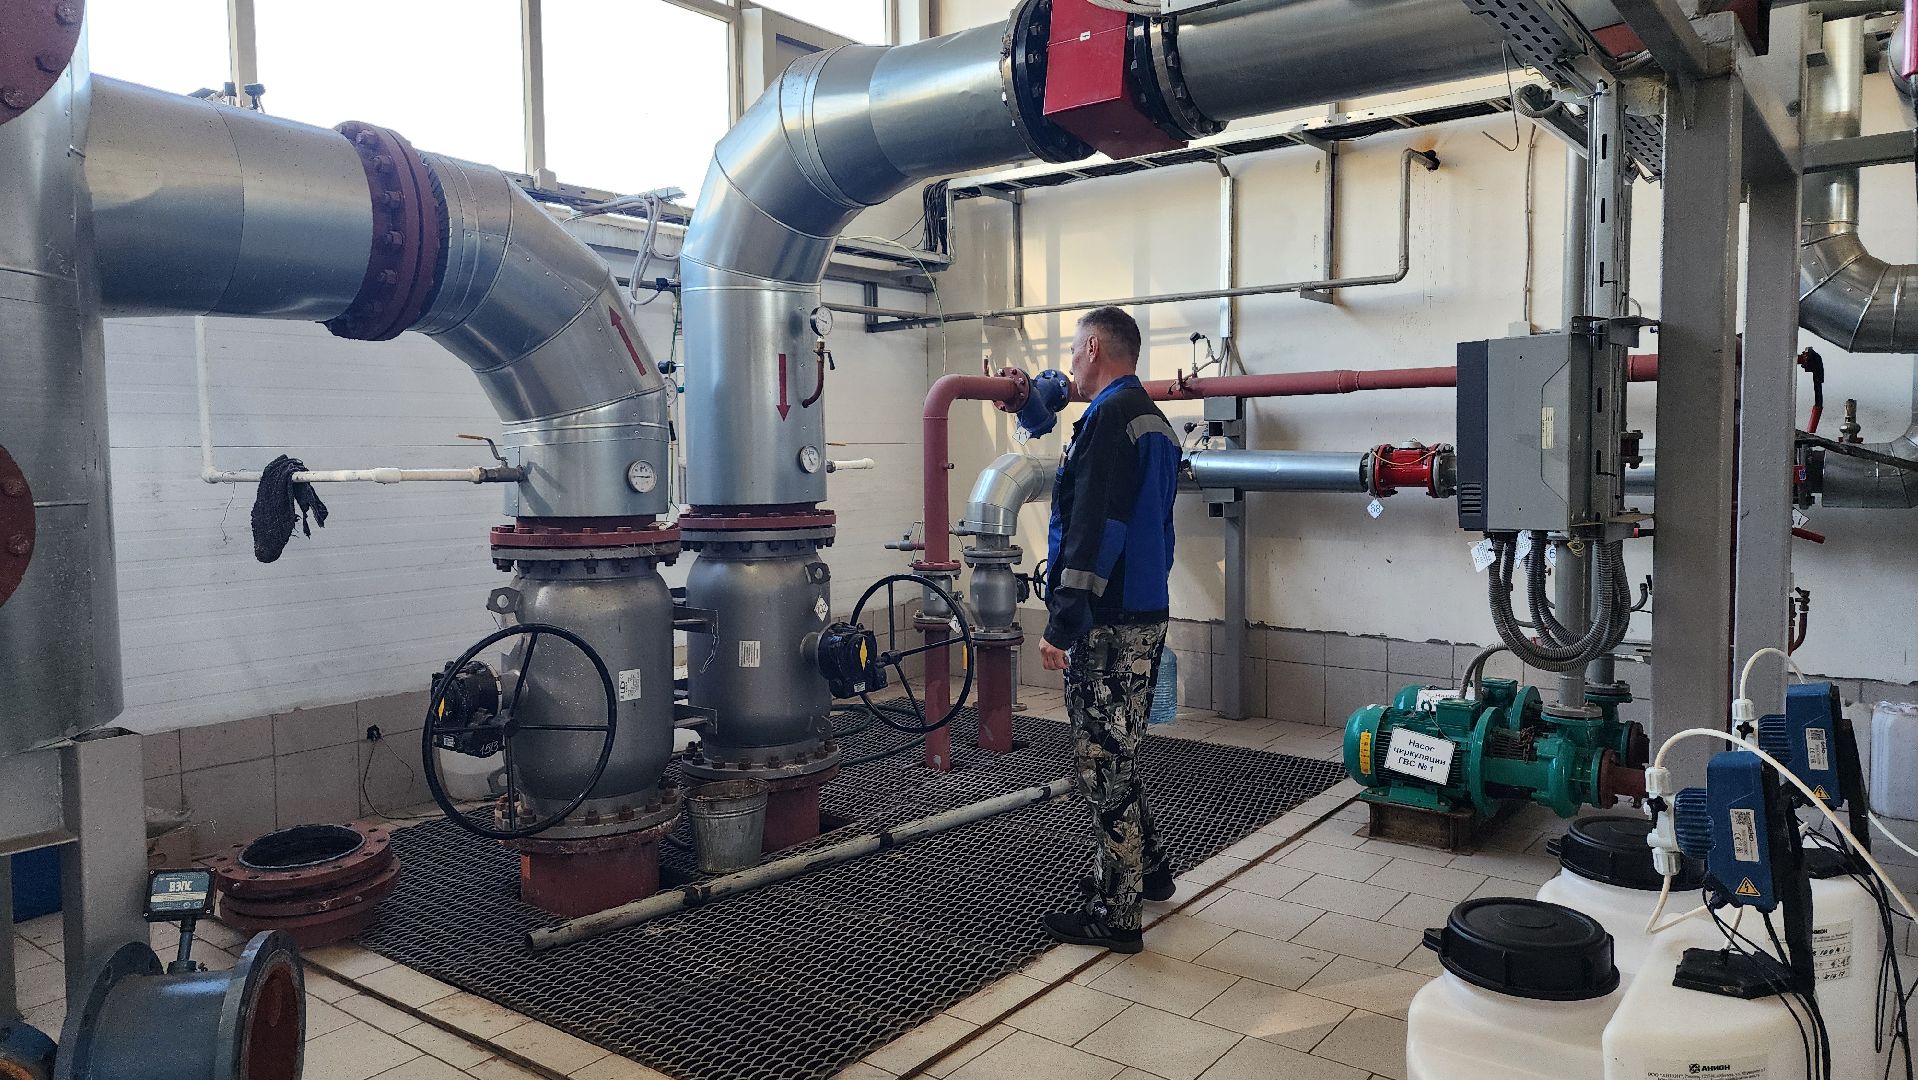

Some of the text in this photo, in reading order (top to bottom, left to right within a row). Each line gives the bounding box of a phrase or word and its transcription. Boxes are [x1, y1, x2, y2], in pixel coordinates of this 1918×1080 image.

[1408, 739, 1435, 752] Насос
[1393, 747, 1446, 765] циркуляции
[1398, 757, 1415, 767] ГВС
[1417, 762, 1428, 771] №
[1701, 1064, 1731, 1072] АНИОН
